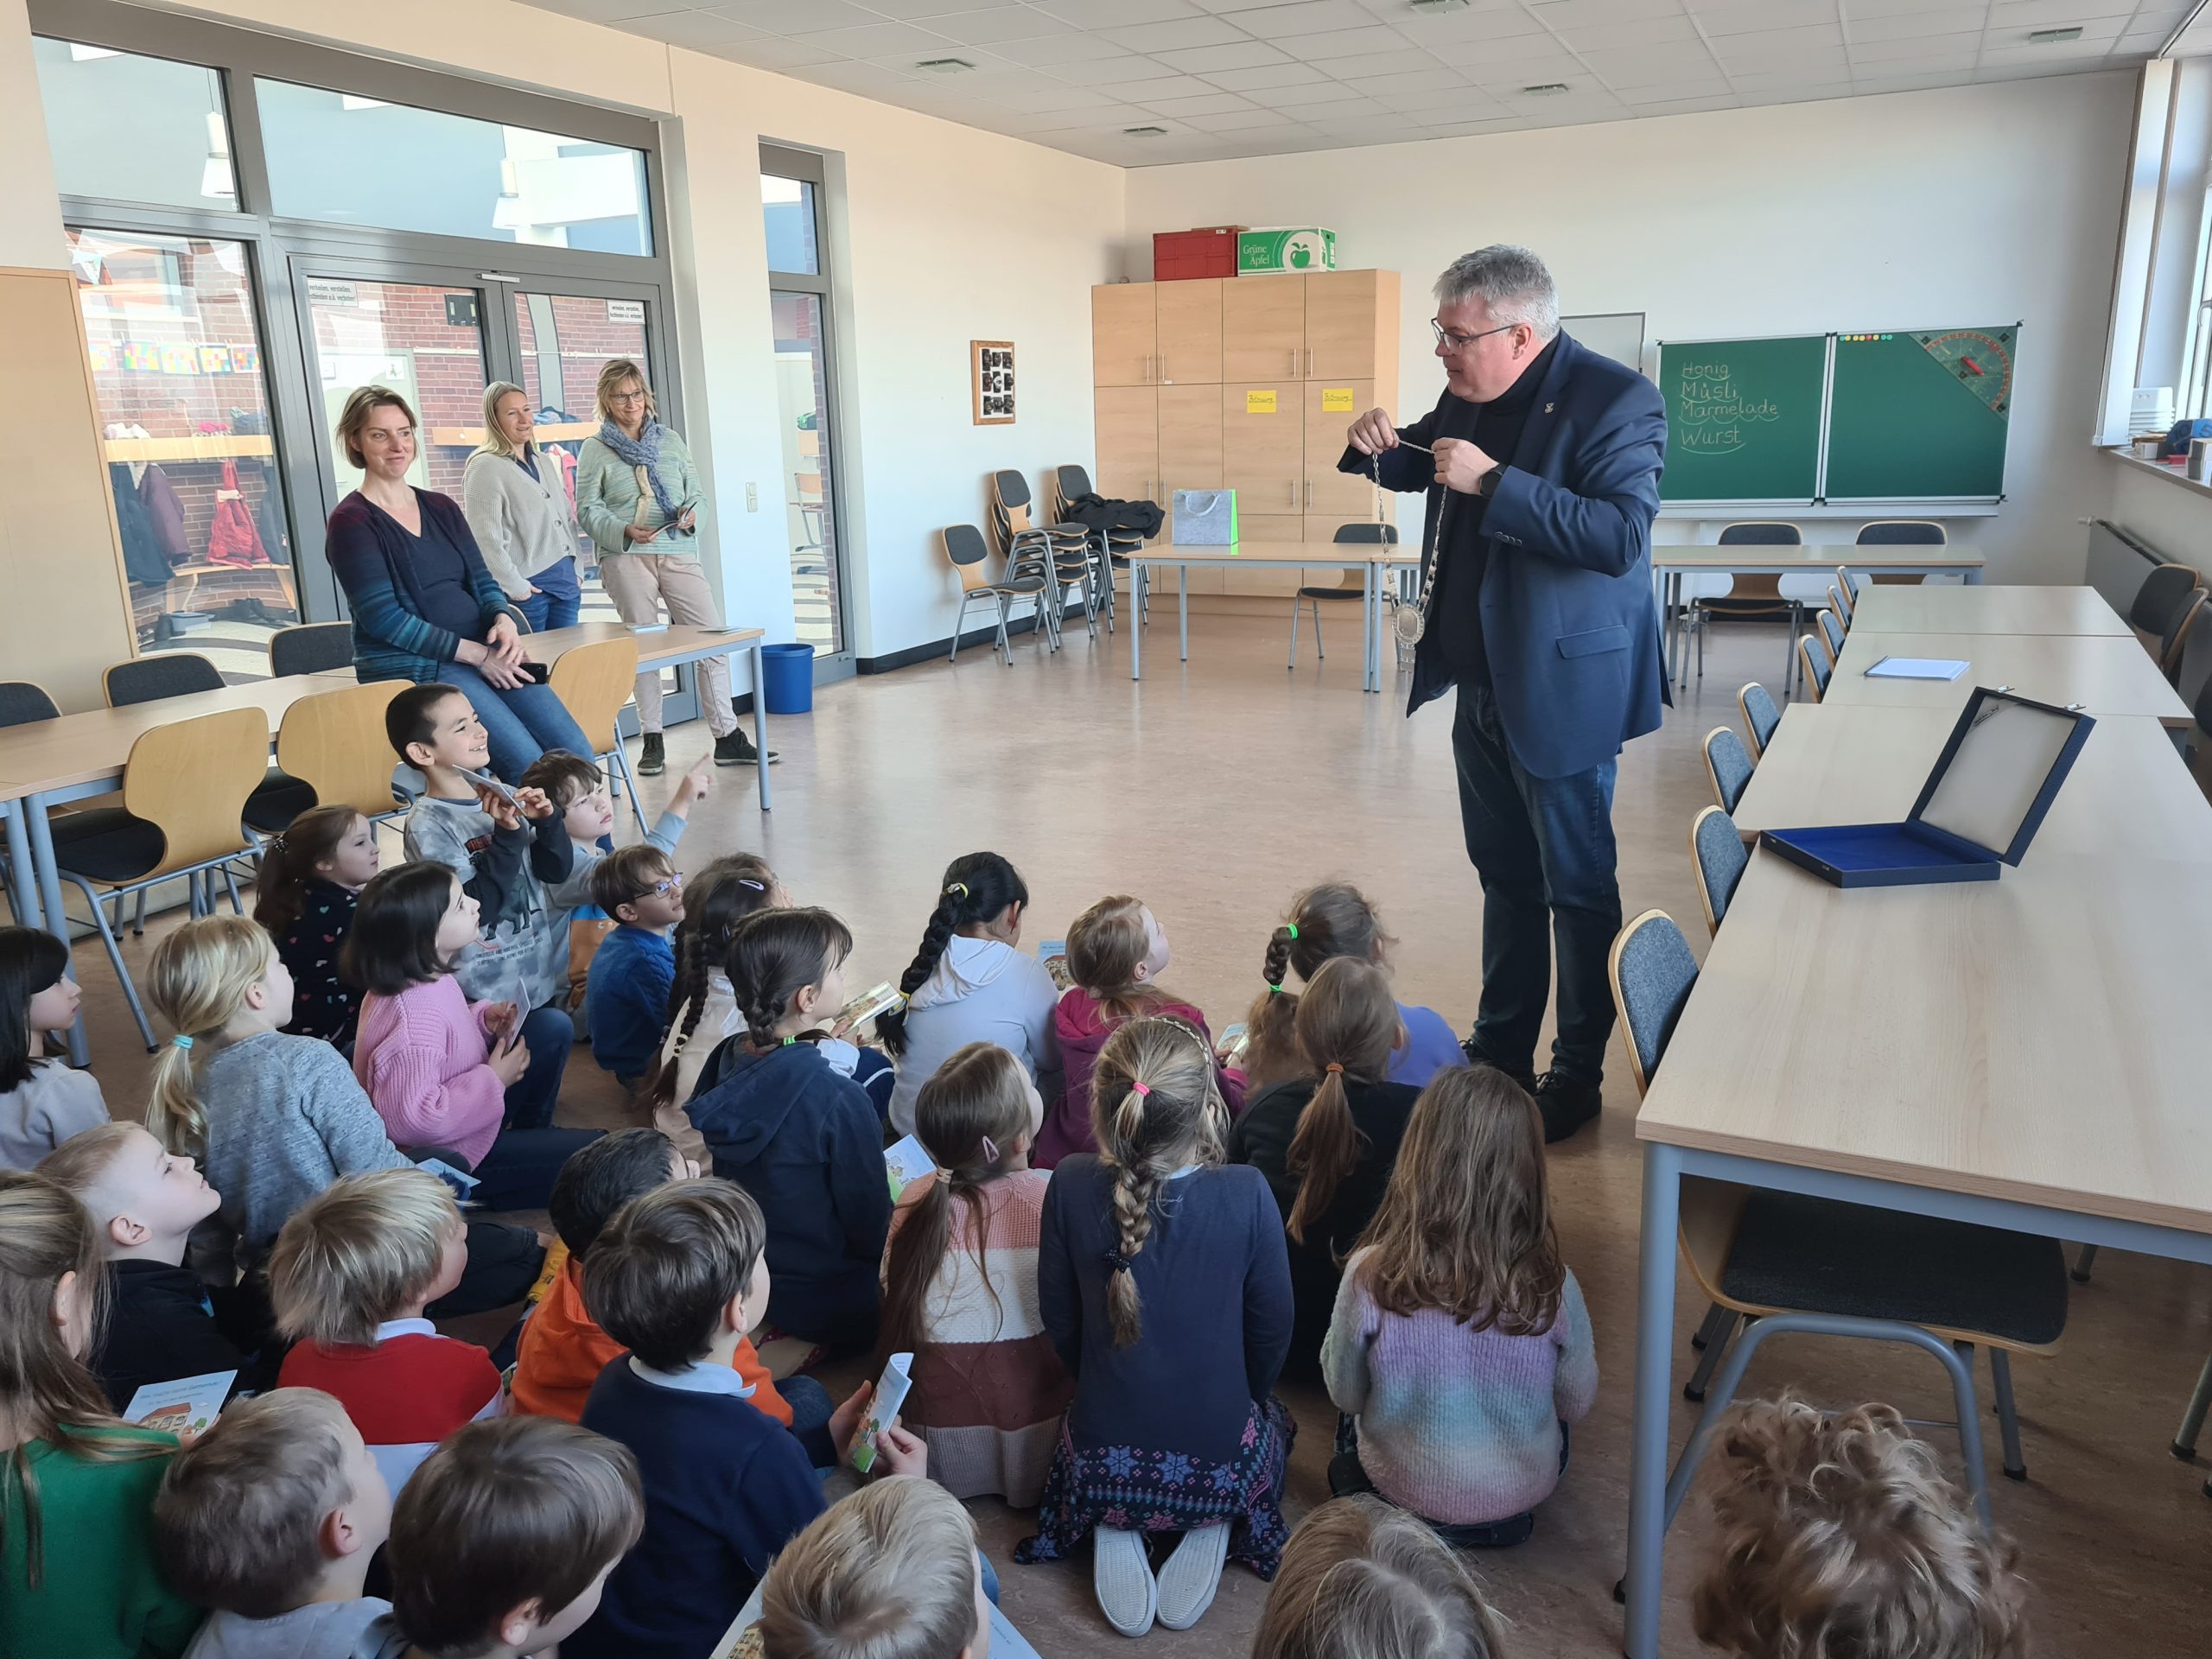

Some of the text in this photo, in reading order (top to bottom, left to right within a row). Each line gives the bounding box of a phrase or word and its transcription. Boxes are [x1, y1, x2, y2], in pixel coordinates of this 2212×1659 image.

[1682, 360, 1729, 380] Honig
[1681, 380, 1737, 399] Müsli
[1681, 397, 1778, 417] Marmelade
[1681, 424, 1742, 445] Wurst
